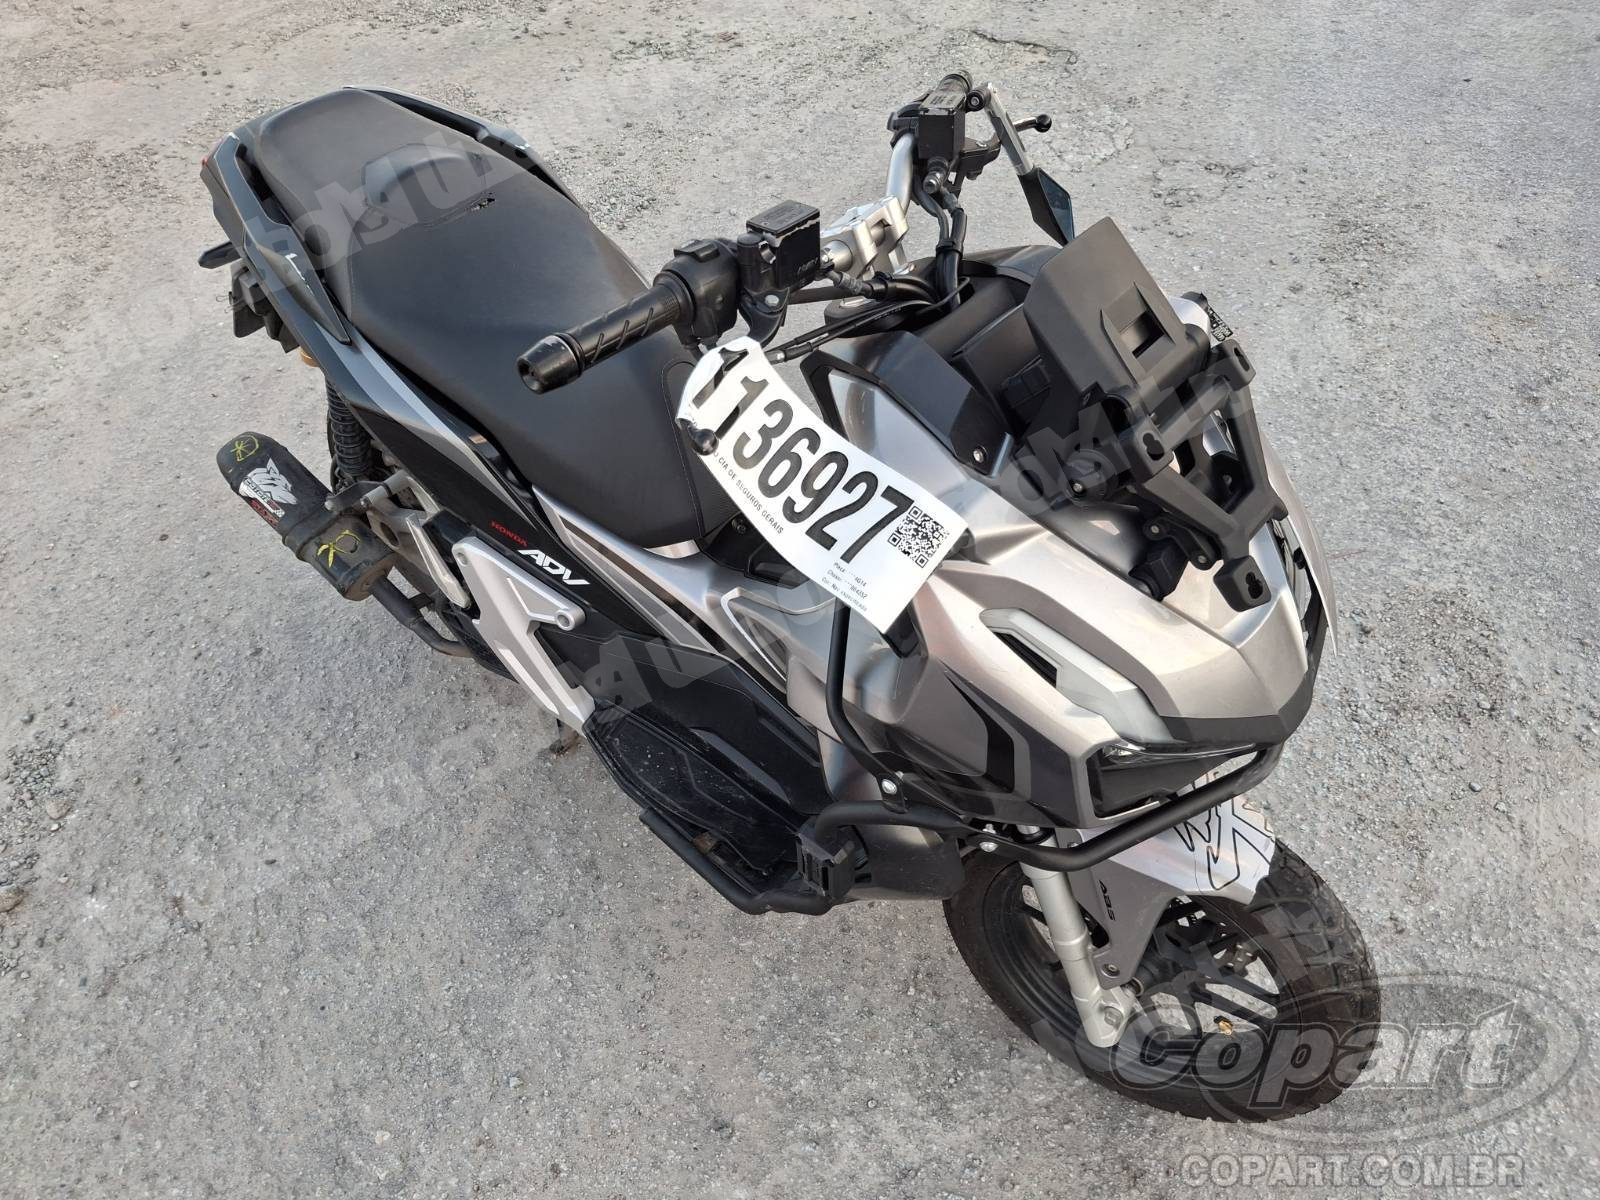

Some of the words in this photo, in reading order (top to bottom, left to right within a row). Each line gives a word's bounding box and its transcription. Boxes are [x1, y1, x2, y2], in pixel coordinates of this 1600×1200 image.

[692, 347, 914, 564] 1136927
[490, 520, 528, 547] HONDA
[761, 510, 784, 534] GERAIS
[517, 549, 591, 586] ADV
[1098, 879, 1116, 921] ABS
